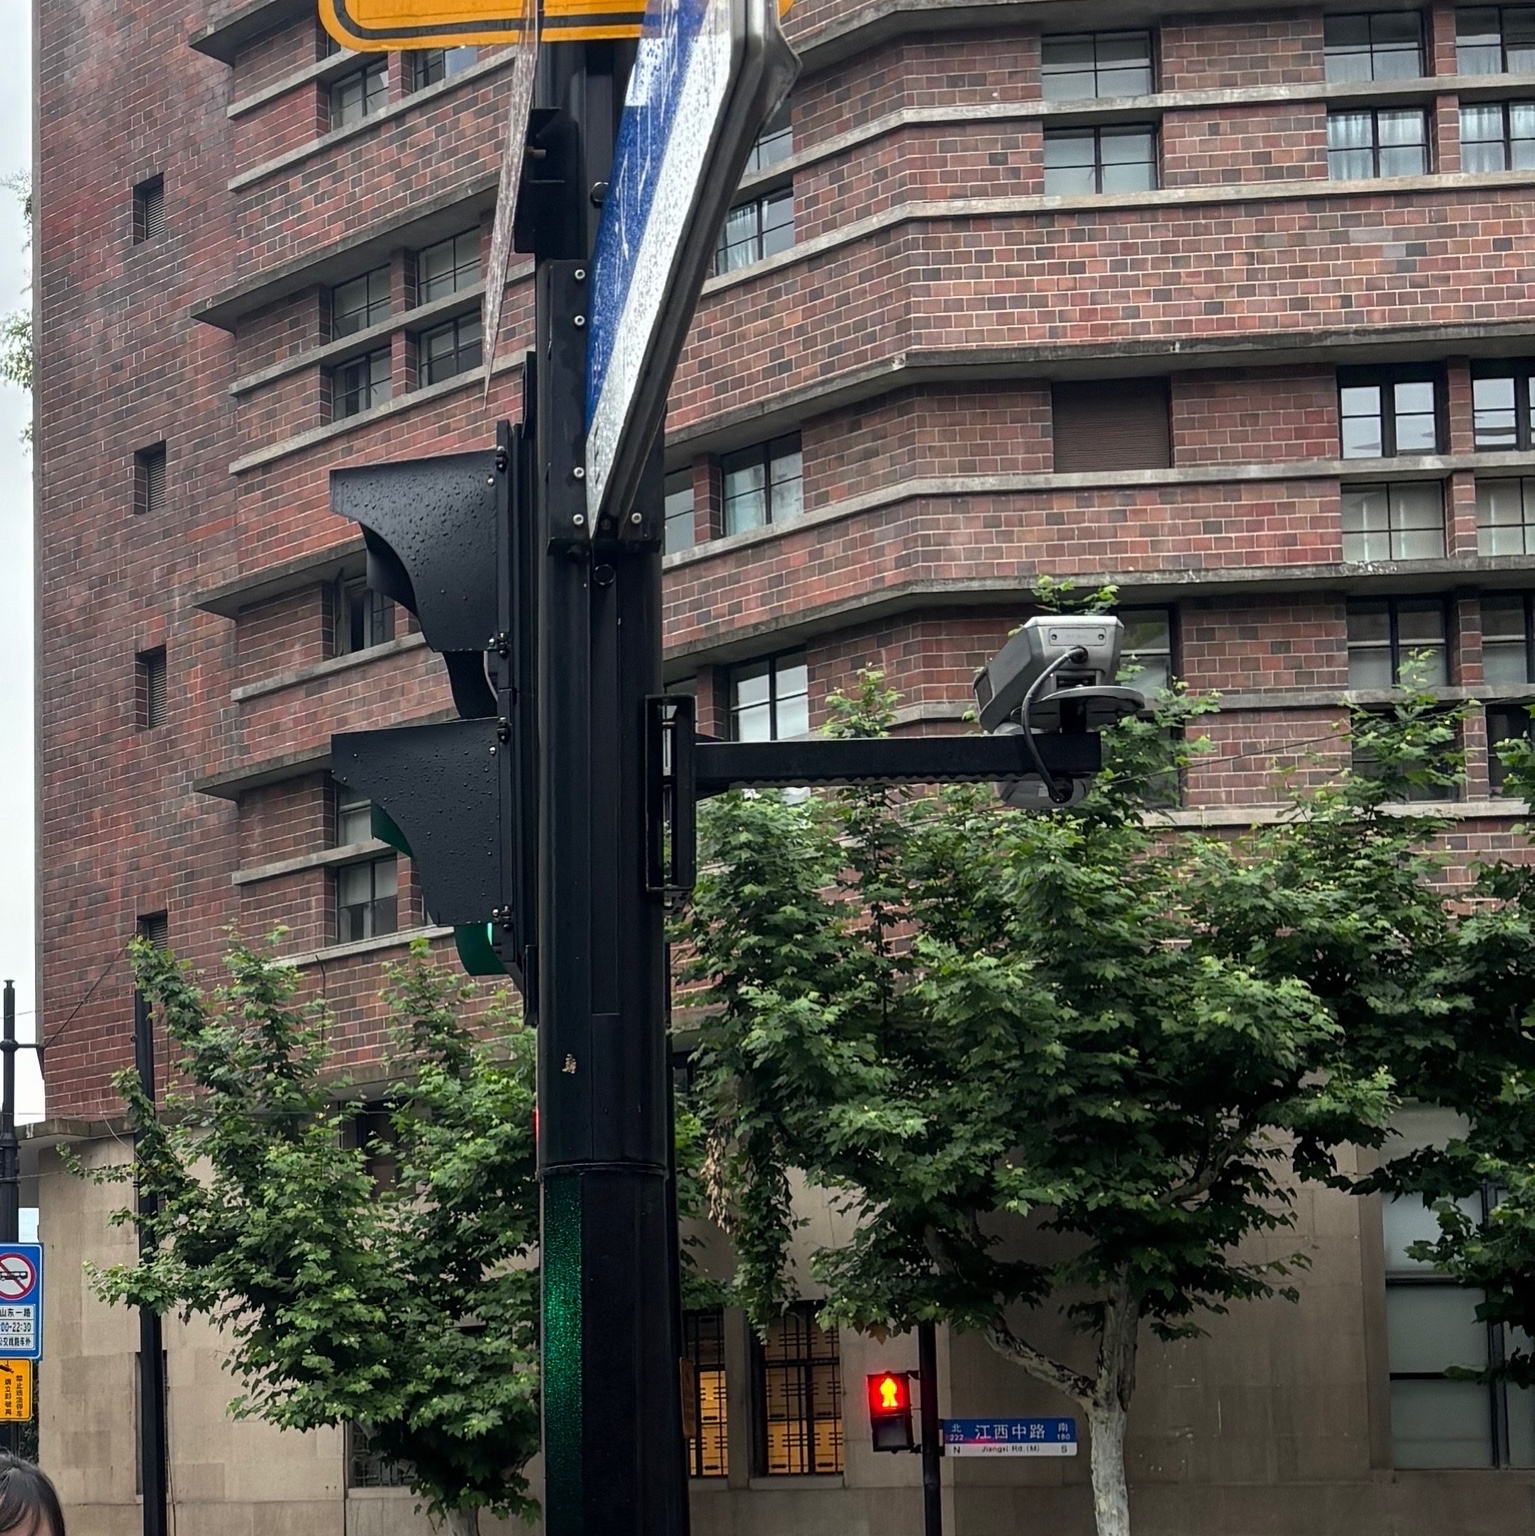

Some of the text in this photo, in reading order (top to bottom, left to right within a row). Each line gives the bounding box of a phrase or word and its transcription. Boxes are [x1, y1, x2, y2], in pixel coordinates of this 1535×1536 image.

[951, 1423, 962, 1433] 北
[975, 1423, 1045, 1440] 江西中路
[953, 1446, 960, 1454] N
